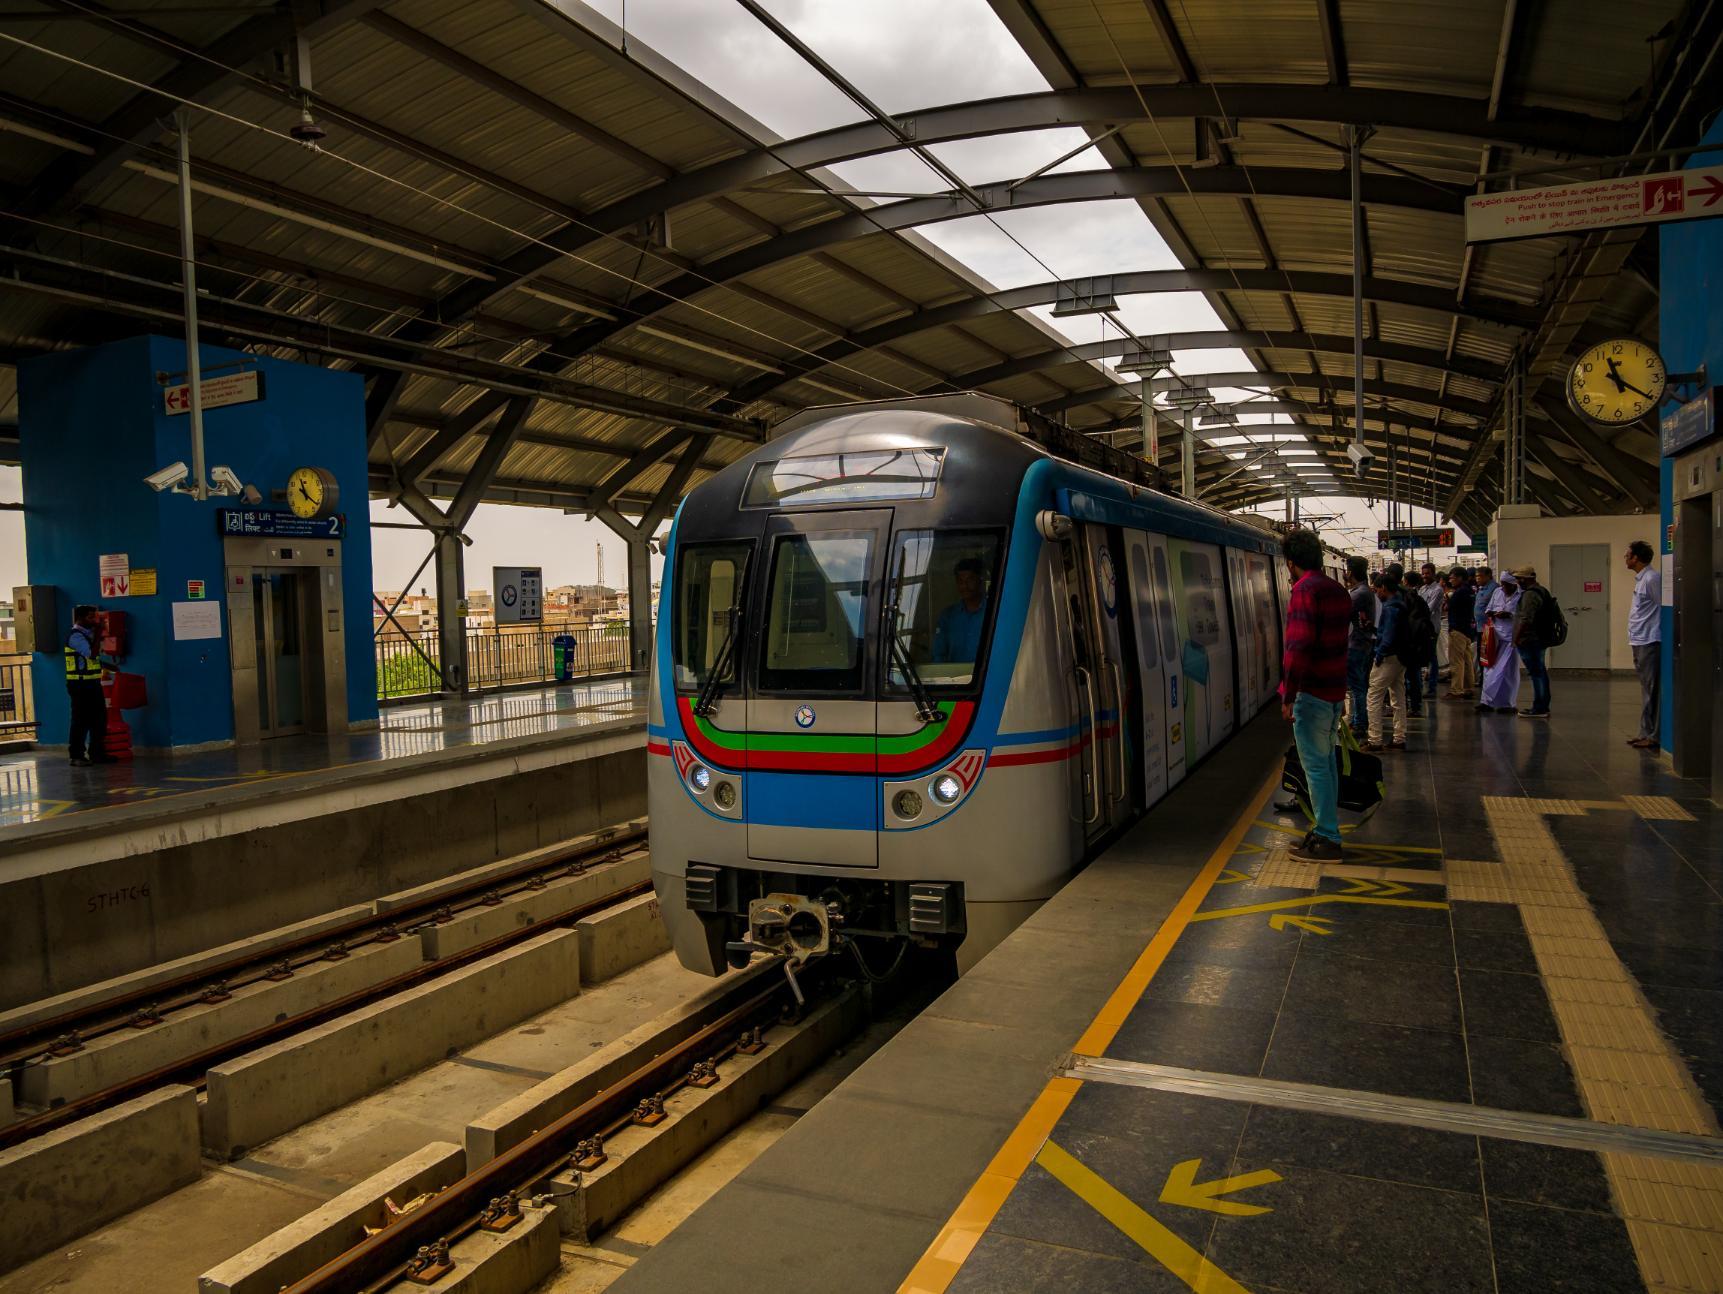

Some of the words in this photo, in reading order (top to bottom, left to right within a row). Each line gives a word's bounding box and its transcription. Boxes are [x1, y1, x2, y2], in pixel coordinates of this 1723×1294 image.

[1518, 203, 1536, 211] Push
[1548, 200, 1566, 209] stop
[1567, 197, 1585, 206] train
[1596, 192, 1640, 203] Emergency
[1612, 345, 1623, 355] 12
[1597, 351, 1605, 360] 11
[1583, 363, 1593, 373] 10
[1646, 358, 1655, 368] 2
[1652, 373, 1659, 383] 3
[1577, 379, 1586, 389] 9
[1583, 394, 1591, 404] 8
[1596, 404, 1604, 414] 7
[1634, 401, 1642, 412] 5
[1614, 408, 1623, 418] 6
[258, 512, 271, 521] Lift
[328, 516, 339, 535] 2
